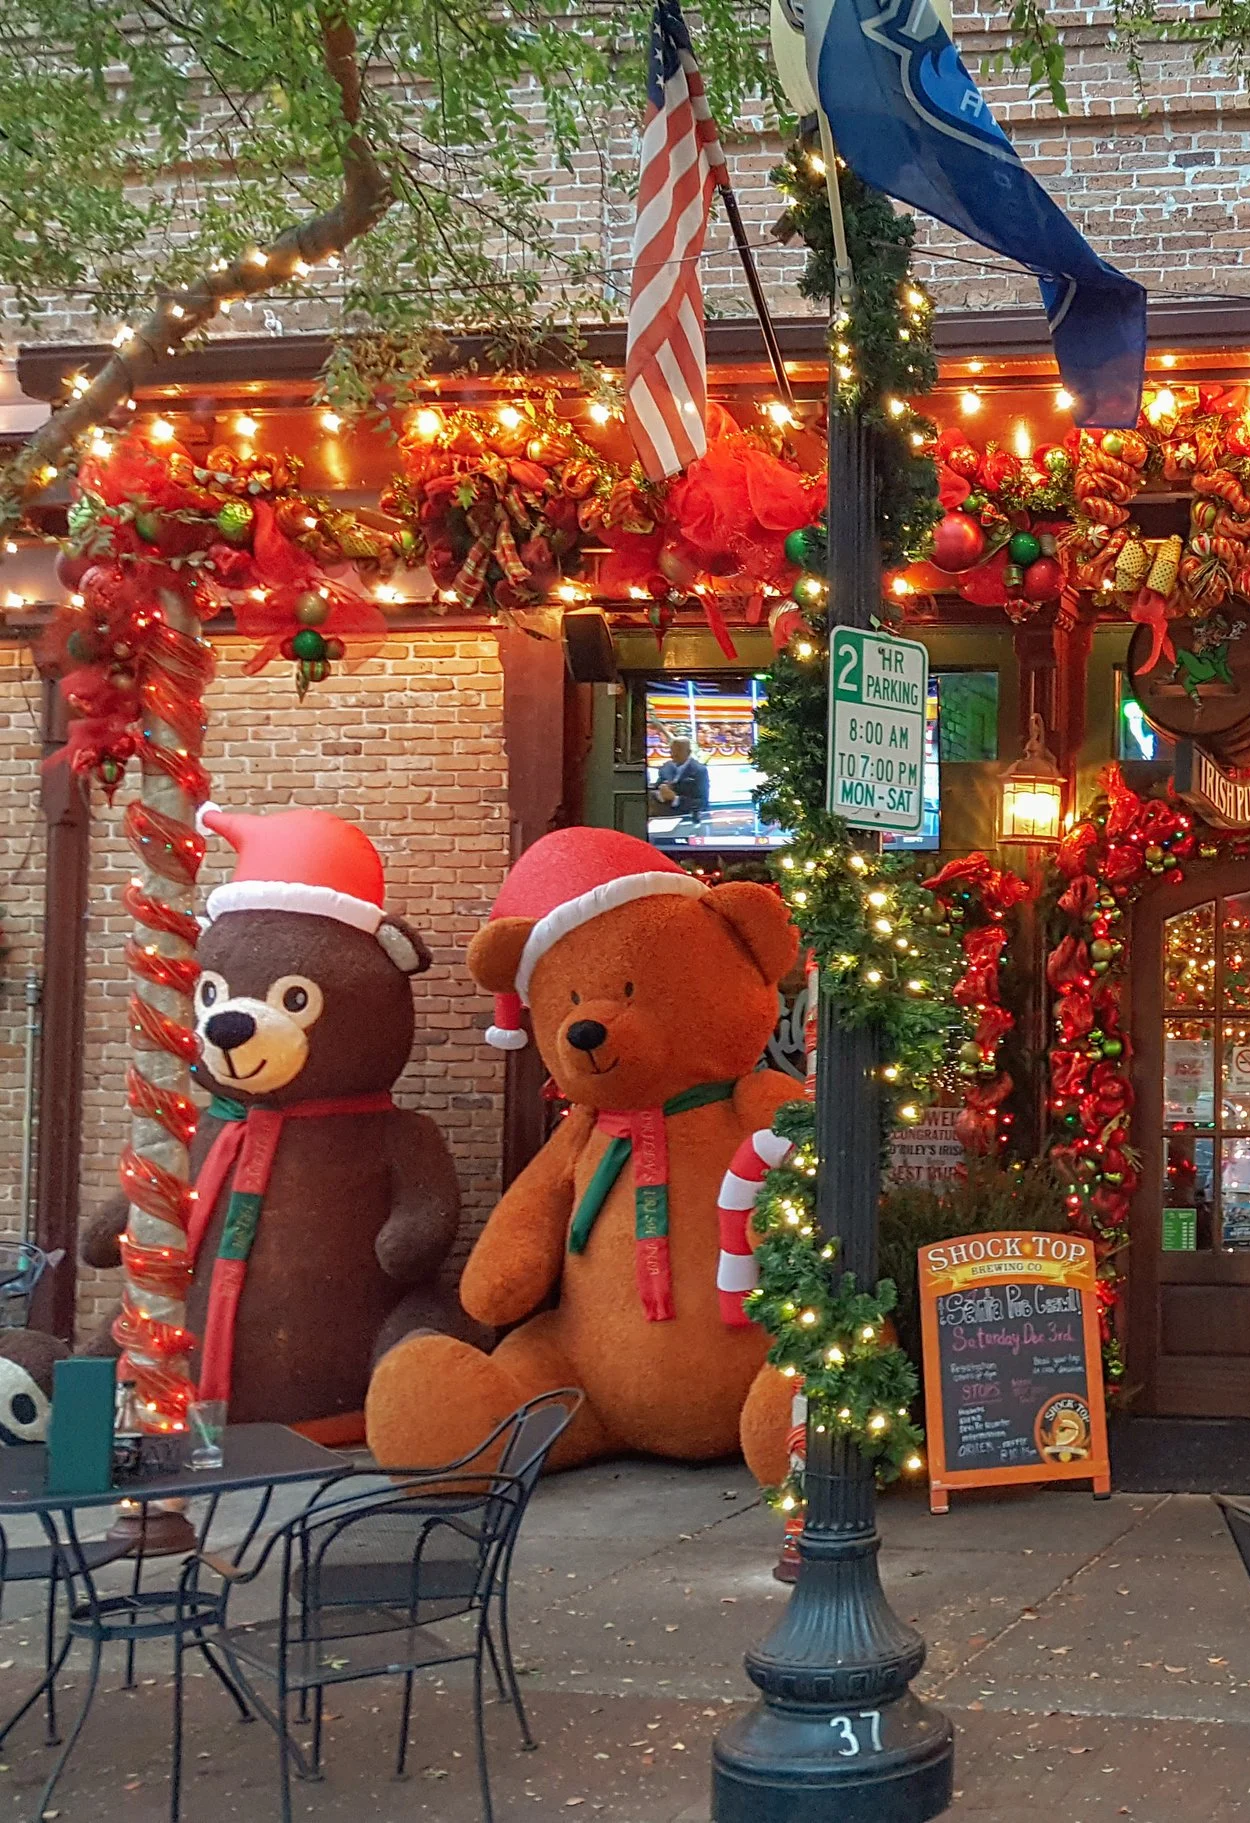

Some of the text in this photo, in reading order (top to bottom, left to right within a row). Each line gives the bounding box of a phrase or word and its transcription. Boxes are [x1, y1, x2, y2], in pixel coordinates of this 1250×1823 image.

[837, 643, 905, 692] 2 HR
[866, 674, 919, 706] PARKING
[849, 717, 909, 750] 8:00 AM
[838, 752, 917, 787] TO 7:00 PM
[1200, 754, 1235, 821] IRISH
[927, 1236, 1086, 1272] SHOCK TOP
[971, 1262, 1042, 1276] BREWING CO
[951, 1326, 1021, 1356] Saturday
[1023, 1322, 1046, 1346] Dec
[1044, 1398, 1076, 1423] SHOCK
[830, 1710, 884, 1757] 37
